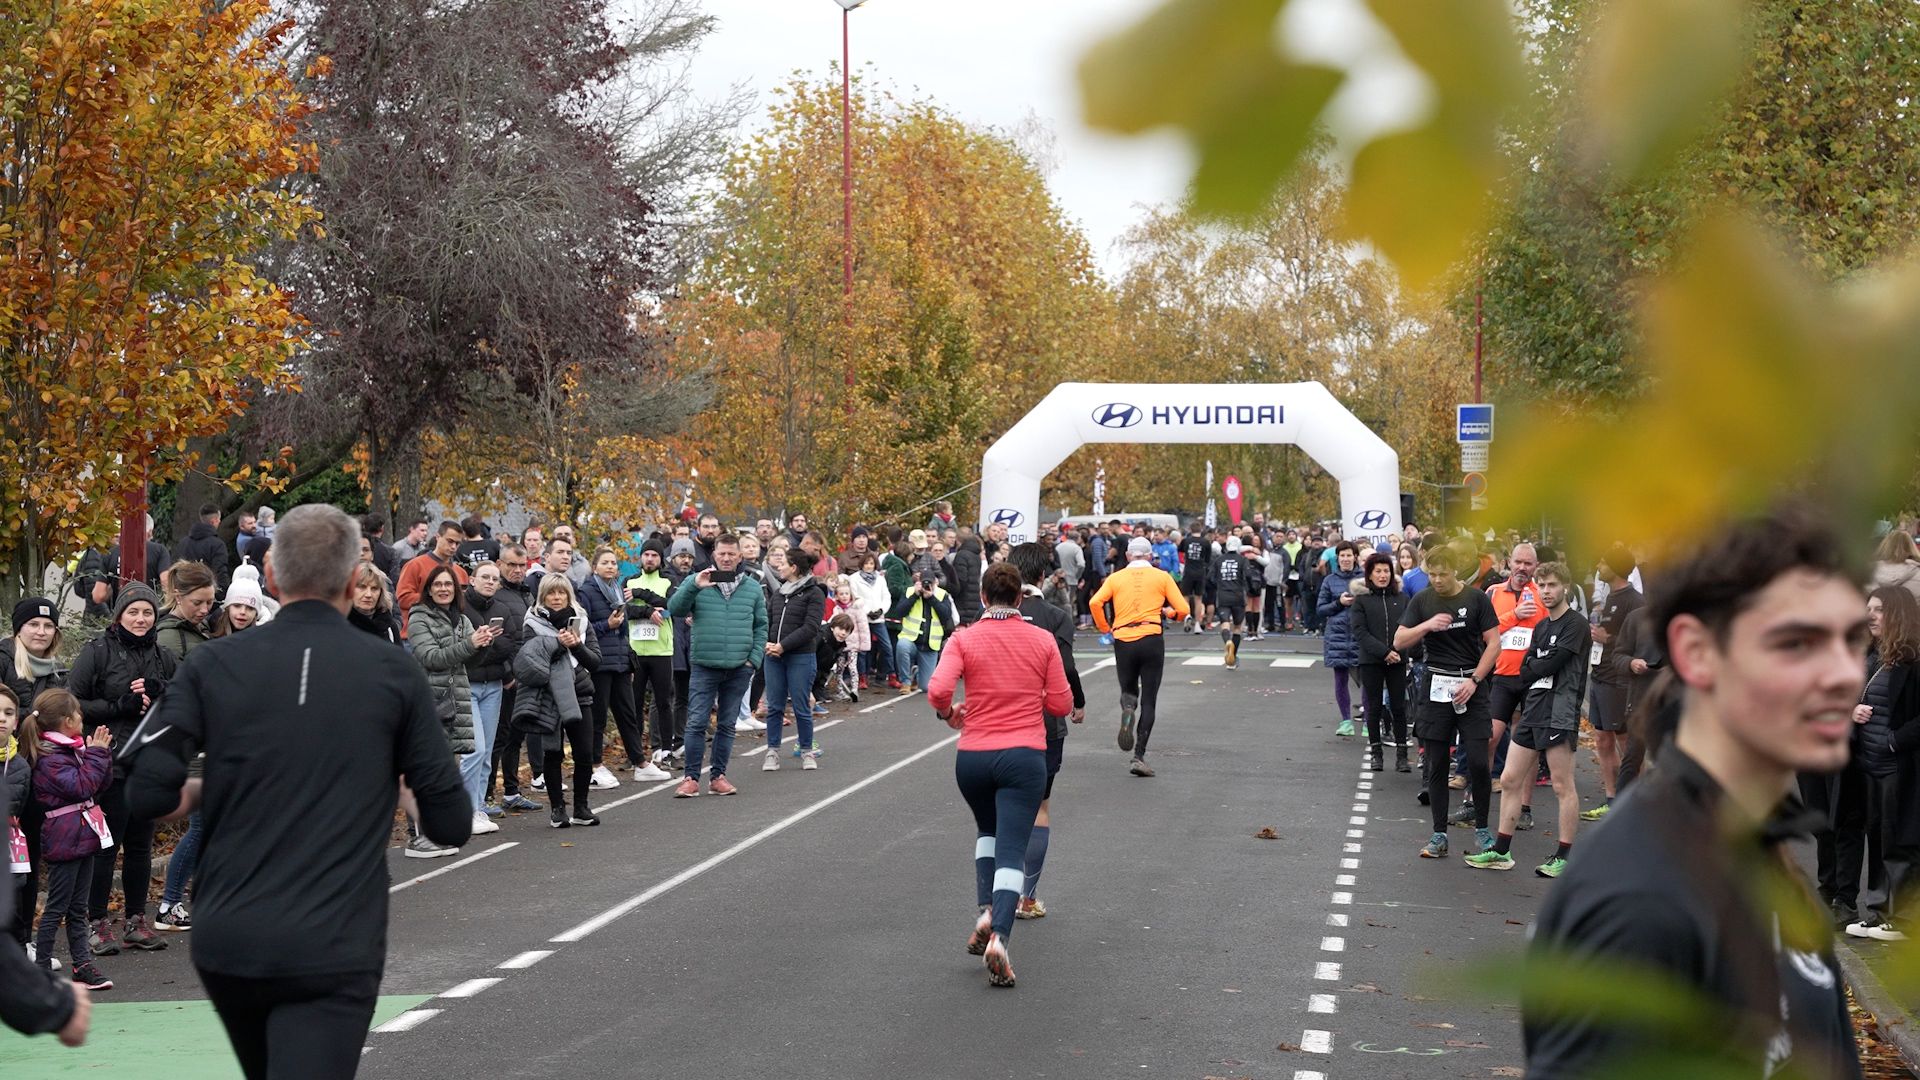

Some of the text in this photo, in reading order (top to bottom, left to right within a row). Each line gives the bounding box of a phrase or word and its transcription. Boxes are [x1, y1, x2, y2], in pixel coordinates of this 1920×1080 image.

[1152, 405, 1285, 425] HYUNDAI
[642, 627, 656, 637] 393
[1512, 635, 1526, 647] 681
